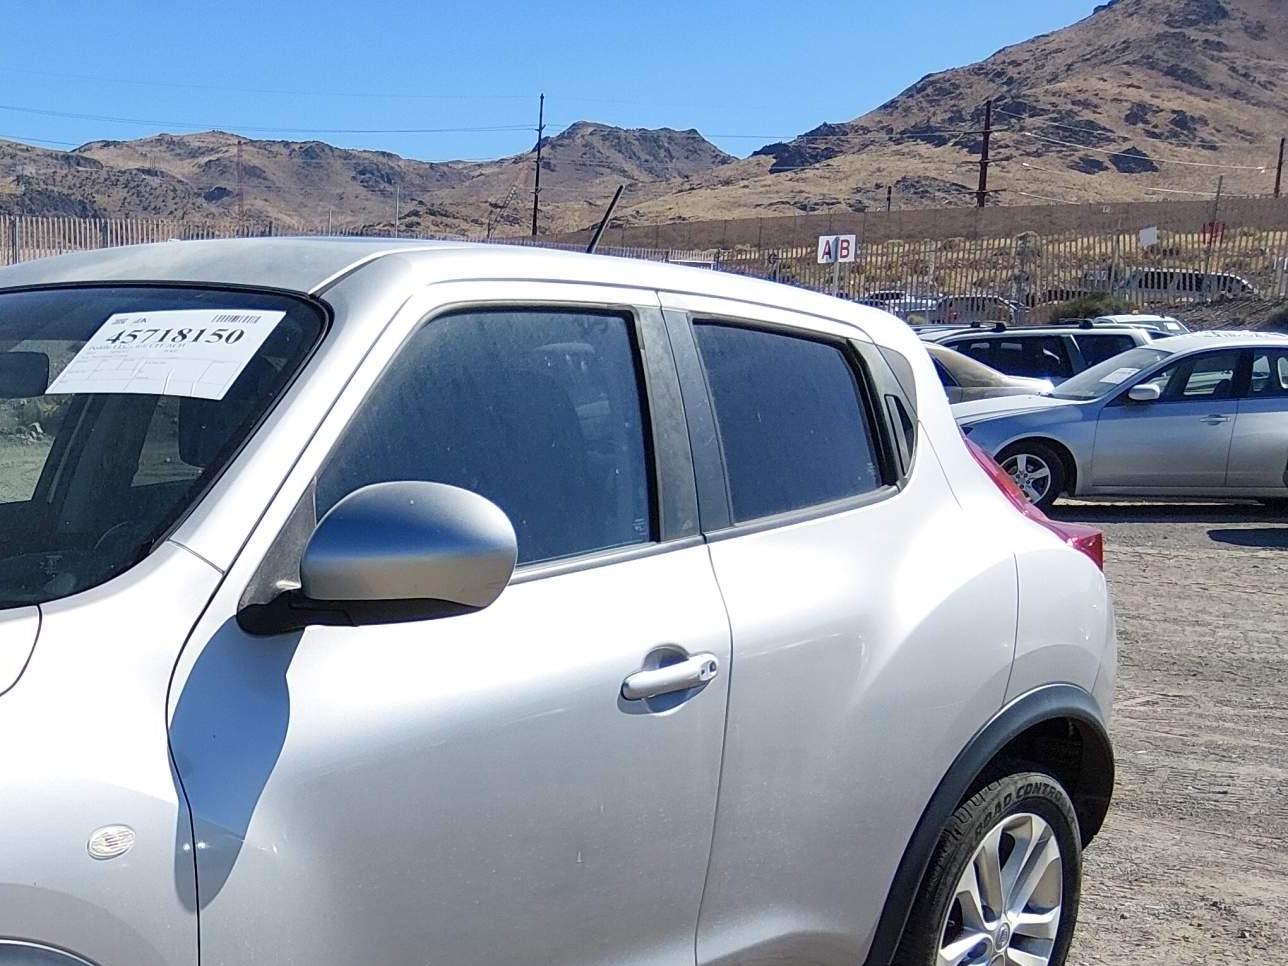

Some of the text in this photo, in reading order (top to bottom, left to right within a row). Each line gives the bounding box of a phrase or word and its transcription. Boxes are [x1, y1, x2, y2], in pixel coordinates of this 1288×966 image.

[821, 239, 851, 260] A B
[105, 328, 245, 345] 45718150
